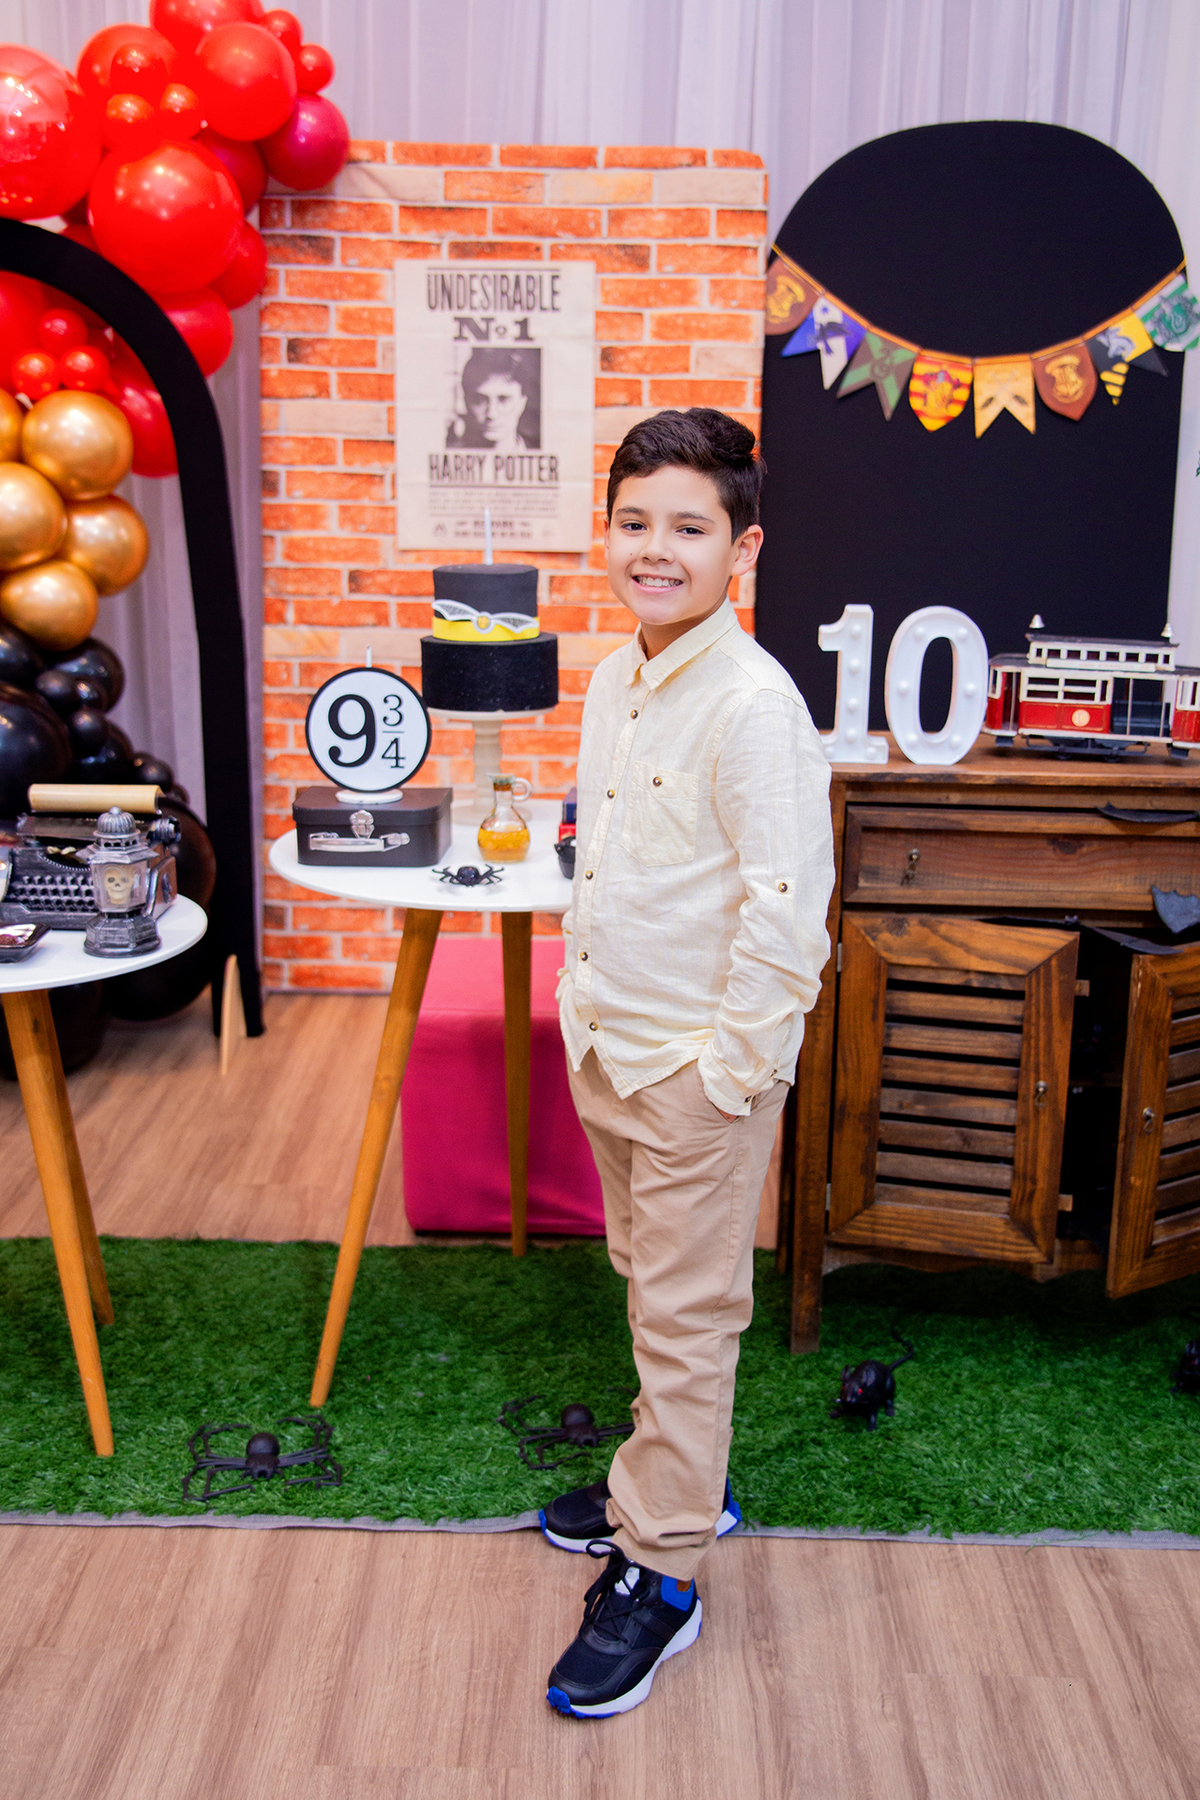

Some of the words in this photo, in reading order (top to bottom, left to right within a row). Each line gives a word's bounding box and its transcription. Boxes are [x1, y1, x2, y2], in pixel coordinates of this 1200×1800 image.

[427, 273, 560, 311] UNDESIRABLE
[429, 454, 486, 481] HARRY
[494, 455, 559, 482] POTTER
[818, 604, 989, 766] 10
